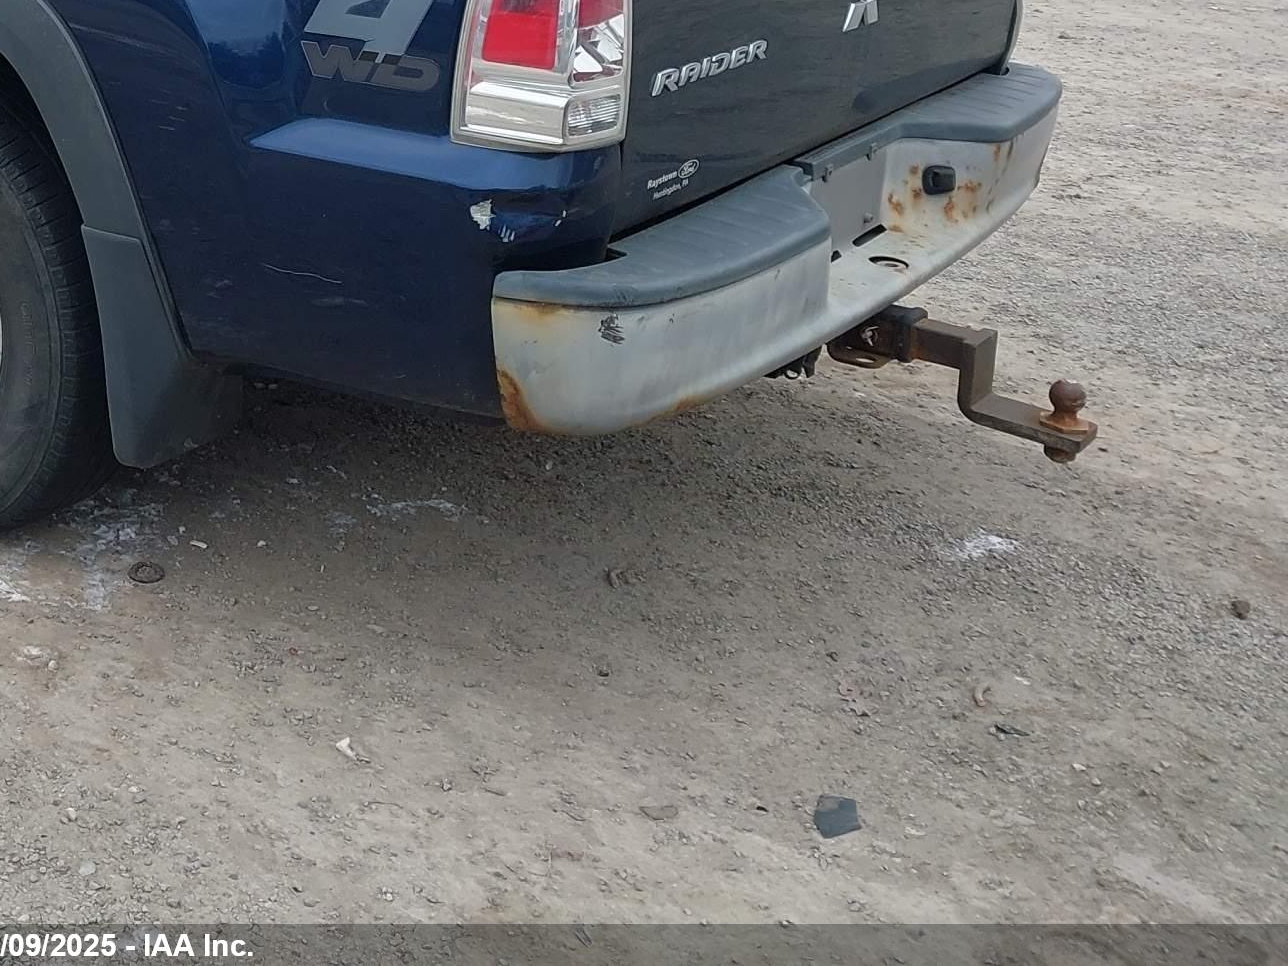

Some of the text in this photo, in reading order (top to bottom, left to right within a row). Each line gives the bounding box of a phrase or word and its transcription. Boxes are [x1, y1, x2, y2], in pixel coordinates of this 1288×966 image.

[300, 40, 440, 92] WD
[652, 39, 768, 97] RAIDER
[647, 170, 678, 190] Raystown
